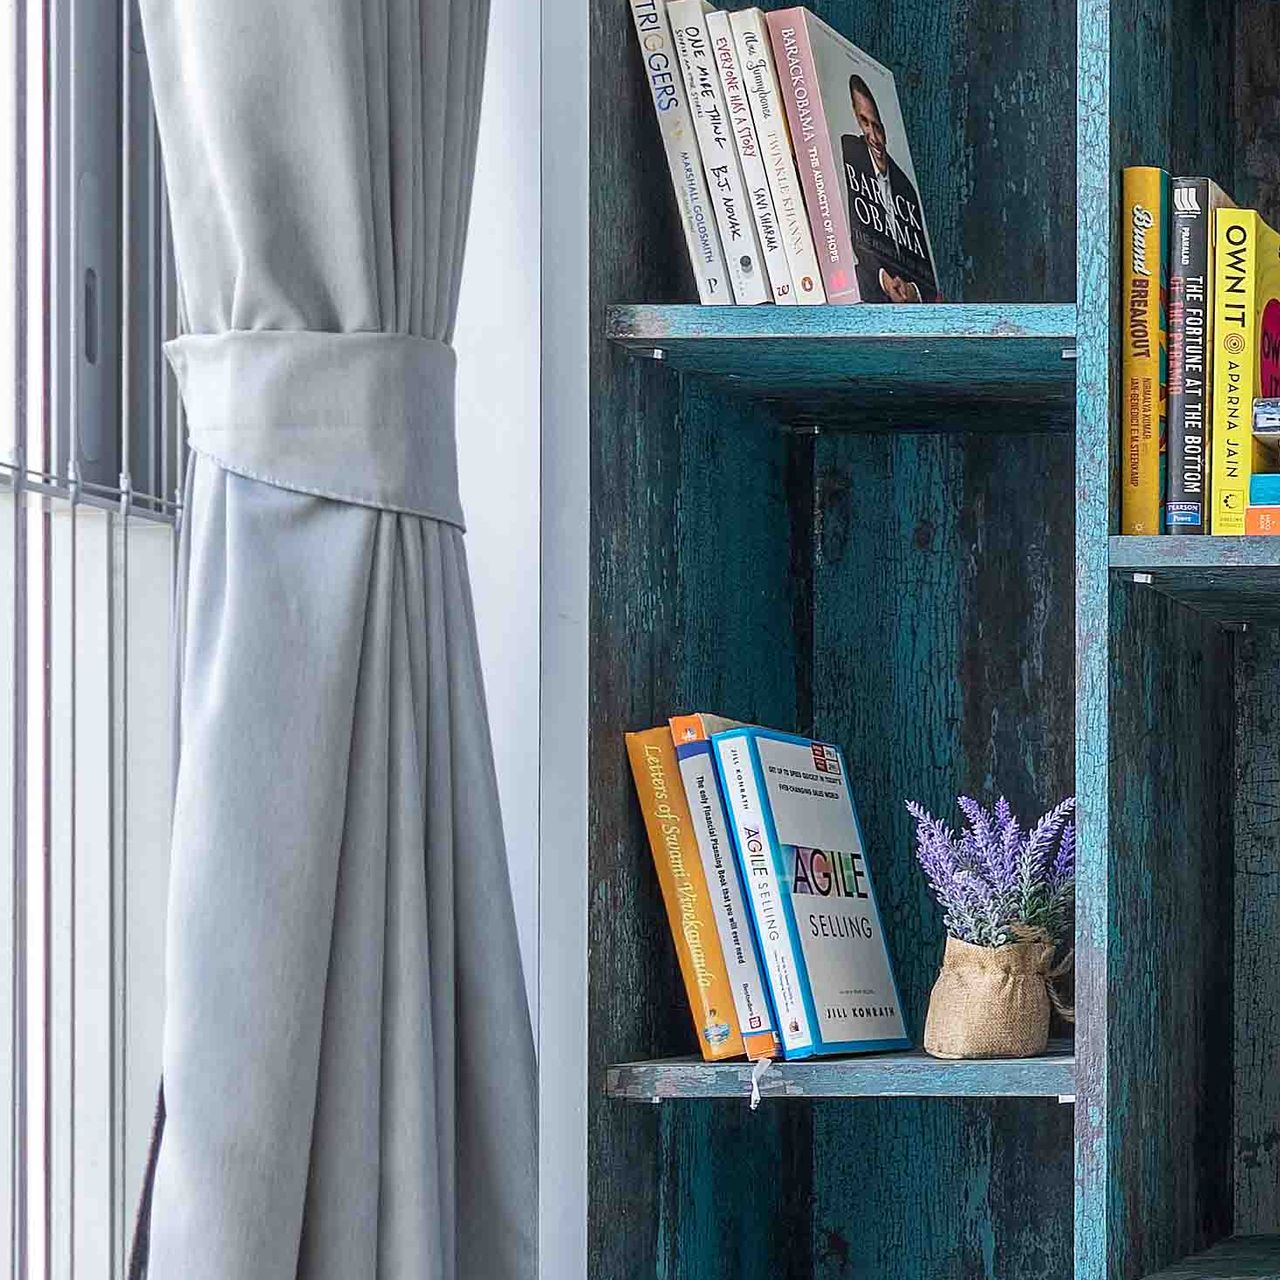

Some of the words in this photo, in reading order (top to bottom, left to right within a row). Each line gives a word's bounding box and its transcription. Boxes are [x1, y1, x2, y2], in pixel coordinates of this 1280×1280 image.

[781, 28, 804, 87] BARACK
[685, 26, 705, 59] ONE
[706, 104, 726, 150] THING
[716, 37, 739, 94] EVERYONE
[737, 126, 756, 158] STORY
[794, 87, 815, 142] OBAMA
[807, 147, 820, 168] THE
[680, 152, 699, 204] MARSHALL
[694, 205, 713, 262] GOLDSMITH
[723, 197, 741, 241] NOVAK
[753, 187, 769, 210] SAVI
[812, 170, 831, 218] AUDACITY
[760, 212, 778, 252] SHARMA
[827, 235, 839, 262] HOPE
[1226, 225, 1246, 292] OWN
[1186, 276, 1203, 304] THE
[1225, 303, 1246, 328] IT
[1131, 279, 1150, 358] BREAKOUT
[1185, 308, 1202, 374] FORTUNE
[1185, 379, 1201, 397] AT
[1227, 361, 1239, 430] APARNA
[1185, 402, 1201, 431] THE
[1184, 436, 1201, 493] BOTTOM
[1226, 438, 1239, 478] JAIN
[663, 821, 691, 878] Swami
[793, 847, 869, 899] AGILE
[744, 827, 768, 877] AGILE
[757, 882, 779, 941] SELLING
[809, 915, 873, 939] SELLING
